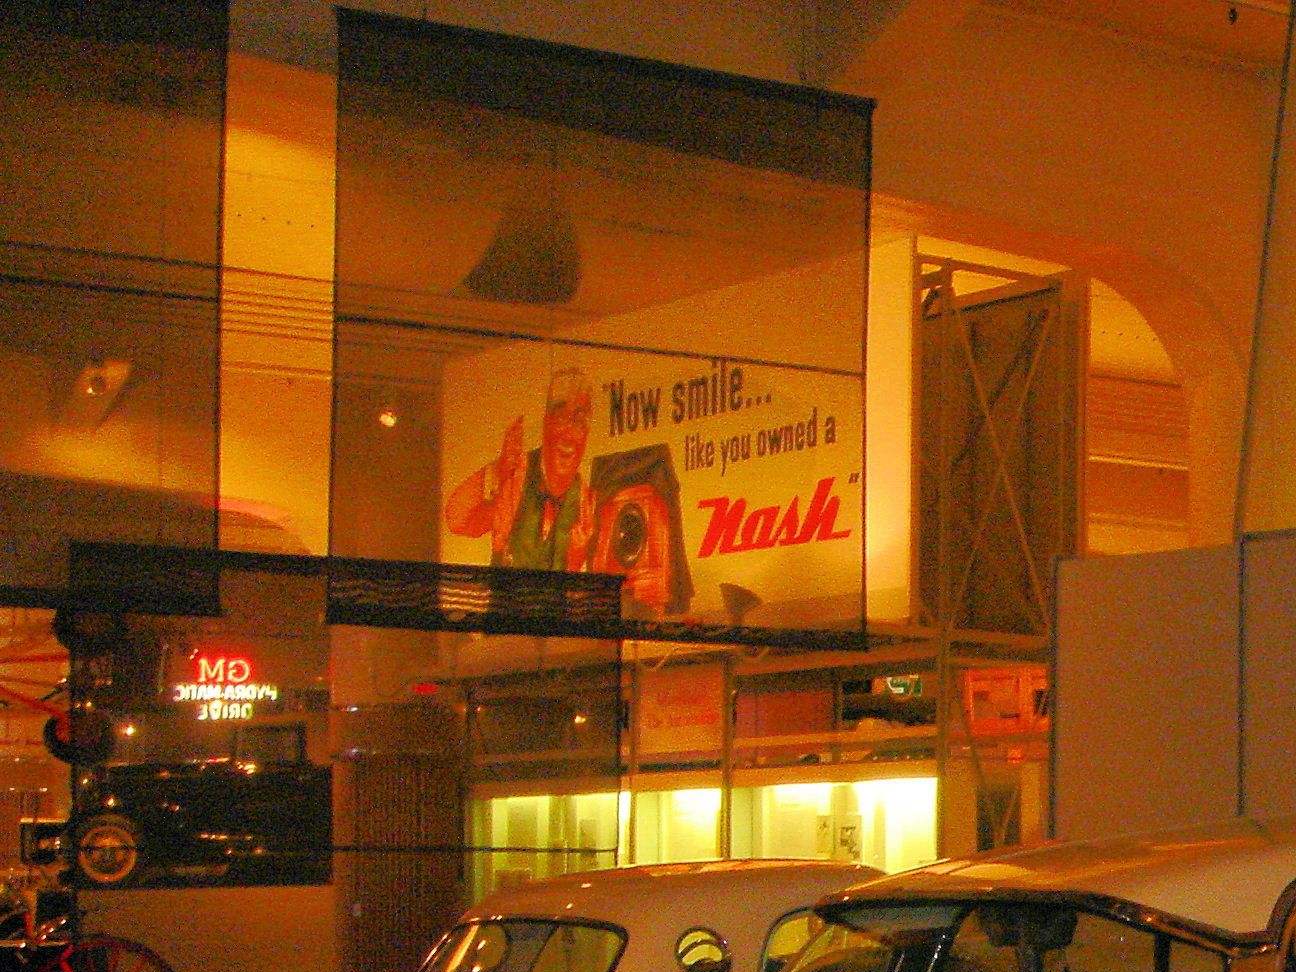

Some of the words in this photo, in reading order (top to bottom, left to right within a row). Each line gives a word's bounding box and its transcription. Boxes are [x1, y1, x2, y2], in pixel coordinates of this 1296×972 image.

[684, 436, 715, 472] like
[720, 433, 751, 478] you
[756, 407, 818, 453] owned
[824, 415, 837, 445] a
